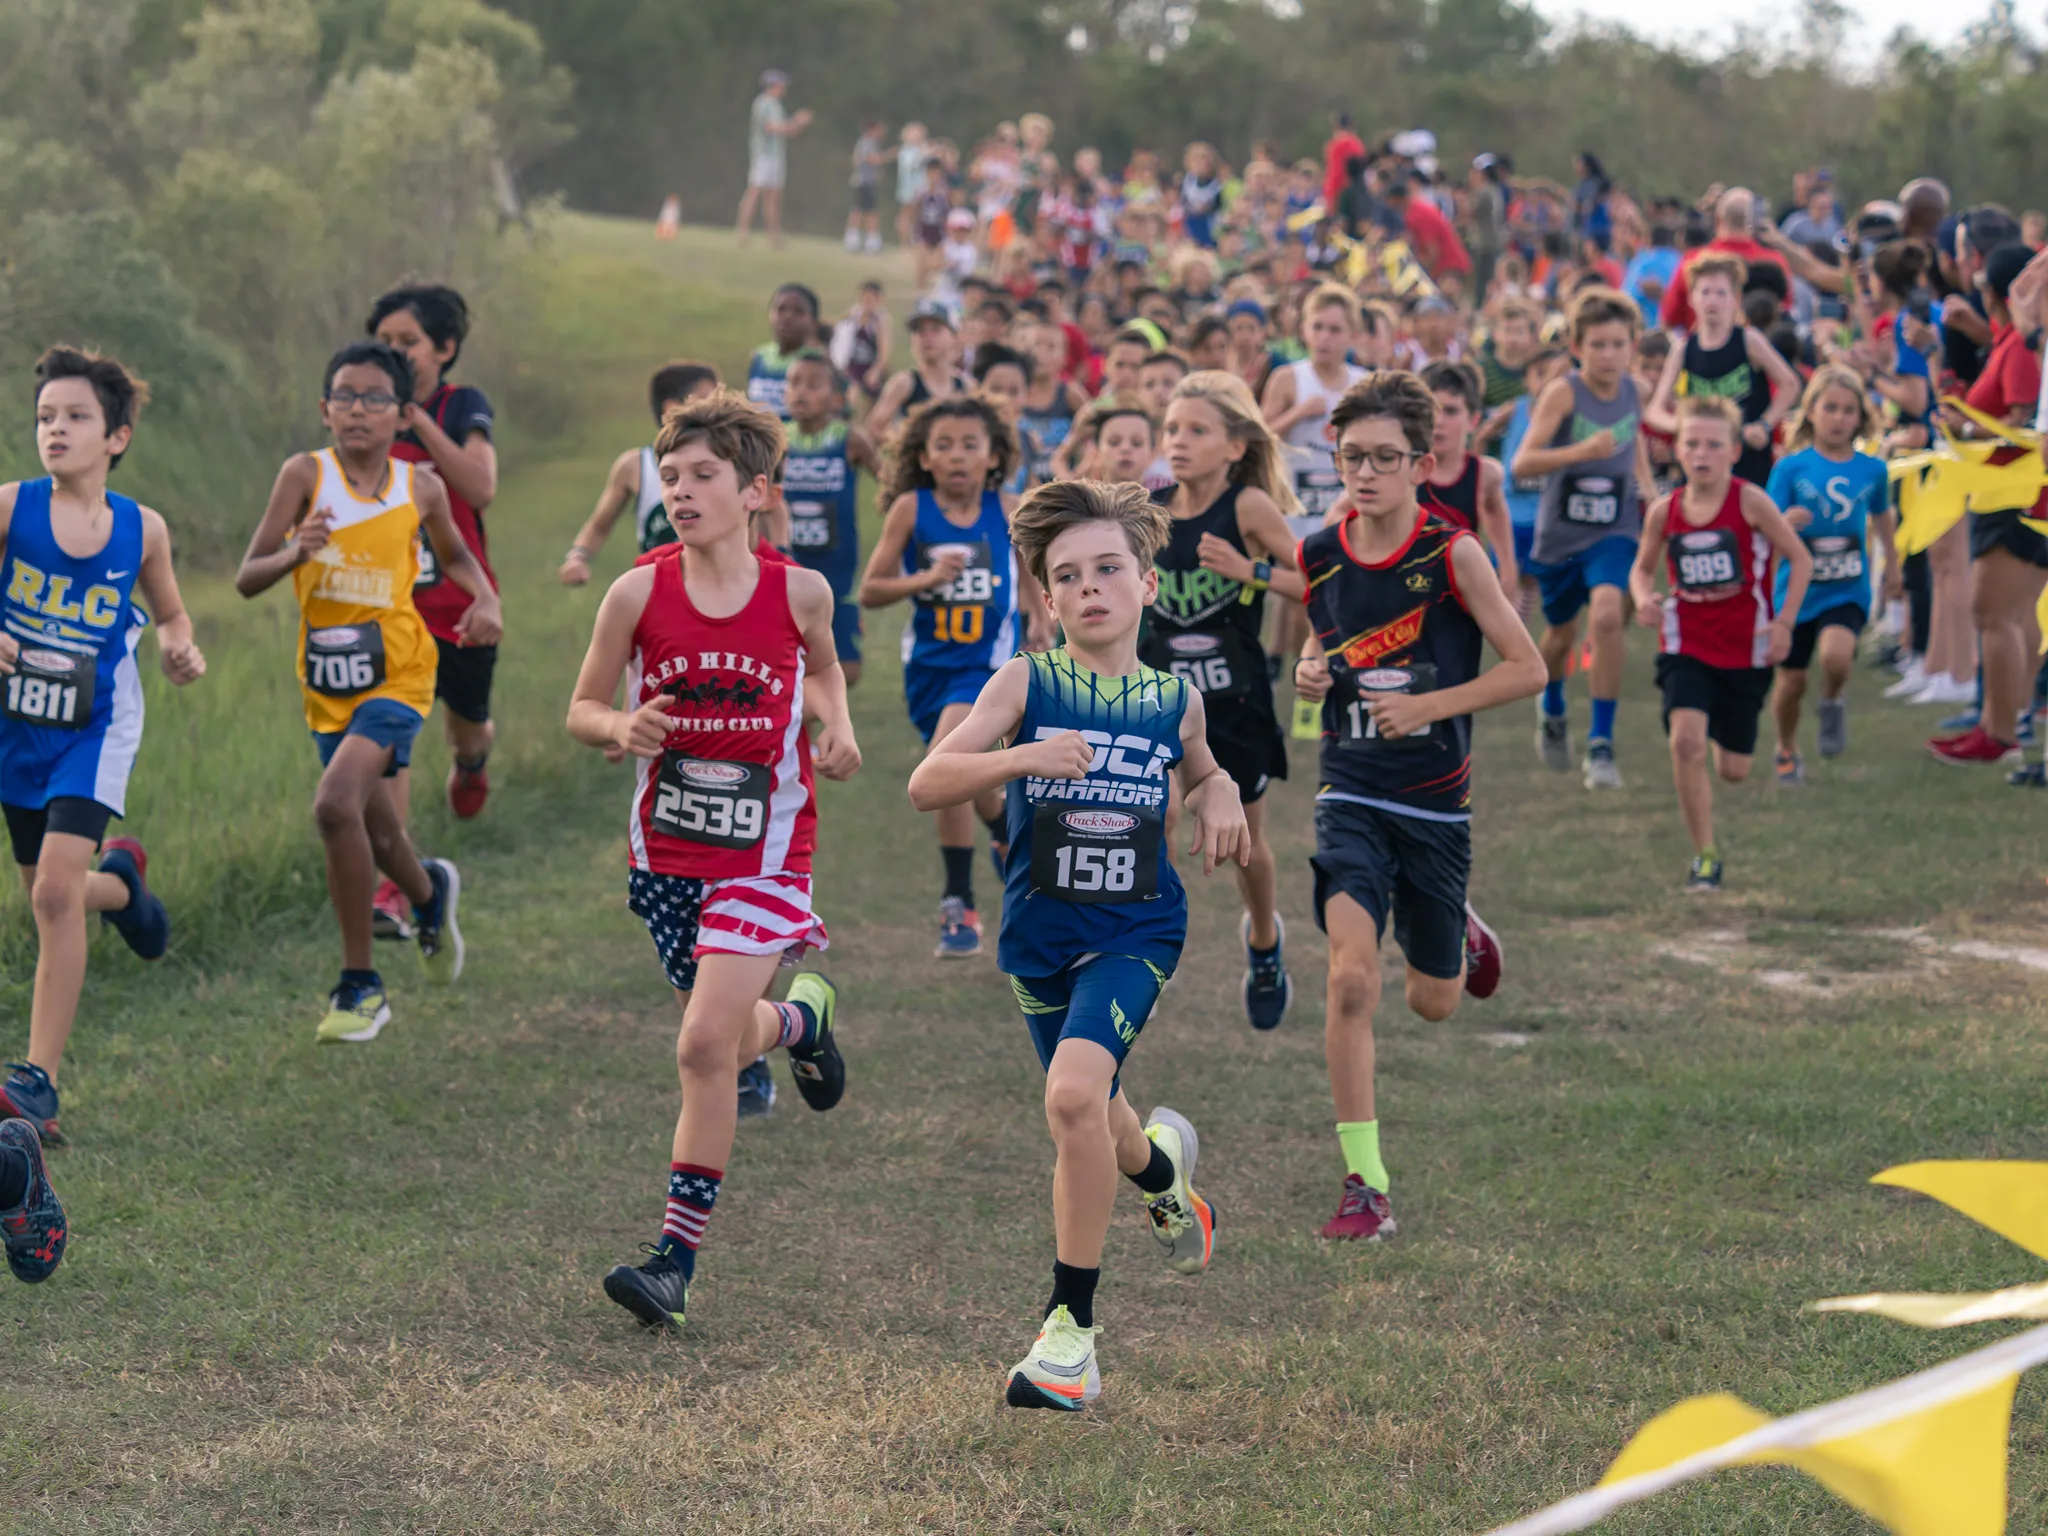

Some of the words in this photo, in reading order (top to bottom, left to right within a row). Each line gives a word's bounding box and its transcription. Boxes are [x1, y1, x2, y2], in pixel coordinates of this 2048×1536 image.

[1679, 550, 1734, 584] 989
[6, 556, 121, 629] RLC
[932, 604, 984, 644] 10
[307, 653, 375, 690] 706
[643, 655, 689, 693] RED
[698, 651, 784, 696] HILLS
[1169, 656, 1233, 693] 516
[7, 674, 78, 723] 1811
[728, 716, 774, 732] CLUB
[1346, 700, 1431, 739] 17
[654, 781, 764, 840] 2539
[1066, 813, 1098, 826] Track
[1100, 815, 1135, 827] Shack
[1056, 845, 1137, 891] 158
